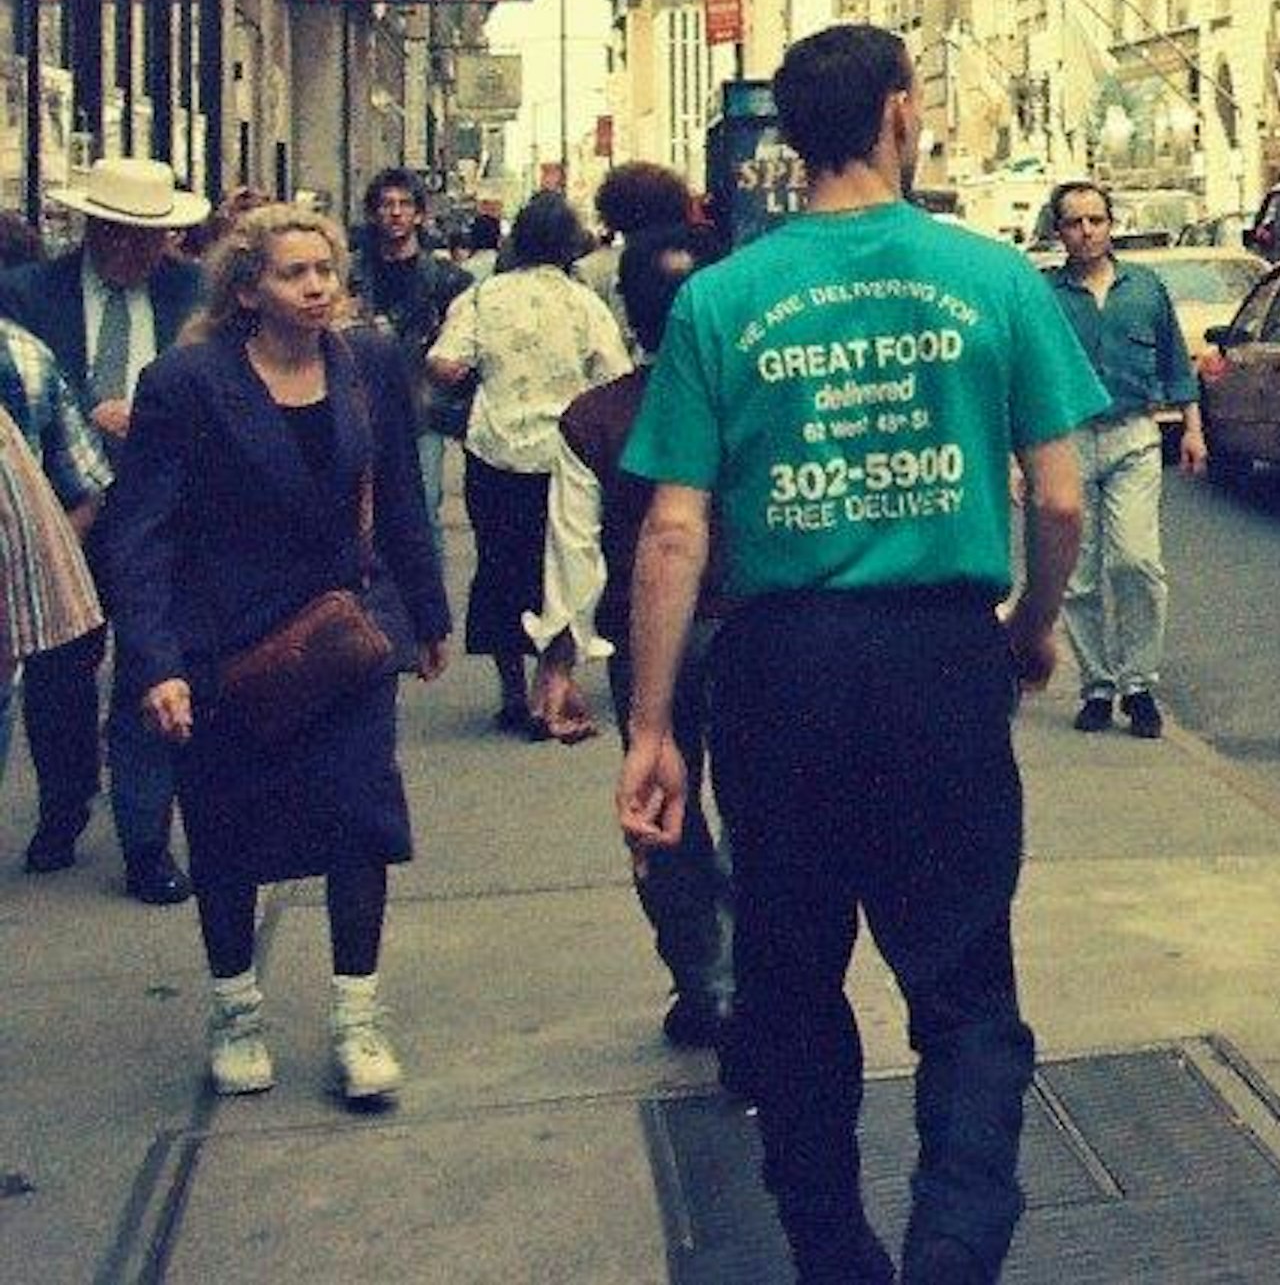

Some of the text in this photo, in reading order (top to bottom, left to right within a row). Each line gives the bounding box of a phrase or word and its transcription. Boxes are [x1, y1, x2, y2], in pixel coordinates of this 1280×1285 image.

[765, 294, 805, 327] ARE
[809, 278, 938, 306] DELIVERING
[938, 293, 979, 327] FOR
[757, 328, 964, 383] GREAT FOOD
[813, 371, 917, 412] delivered
[769, 443, 964, 502] 302-5900
[766, 488, 965, 531] FREE DELIVERY
